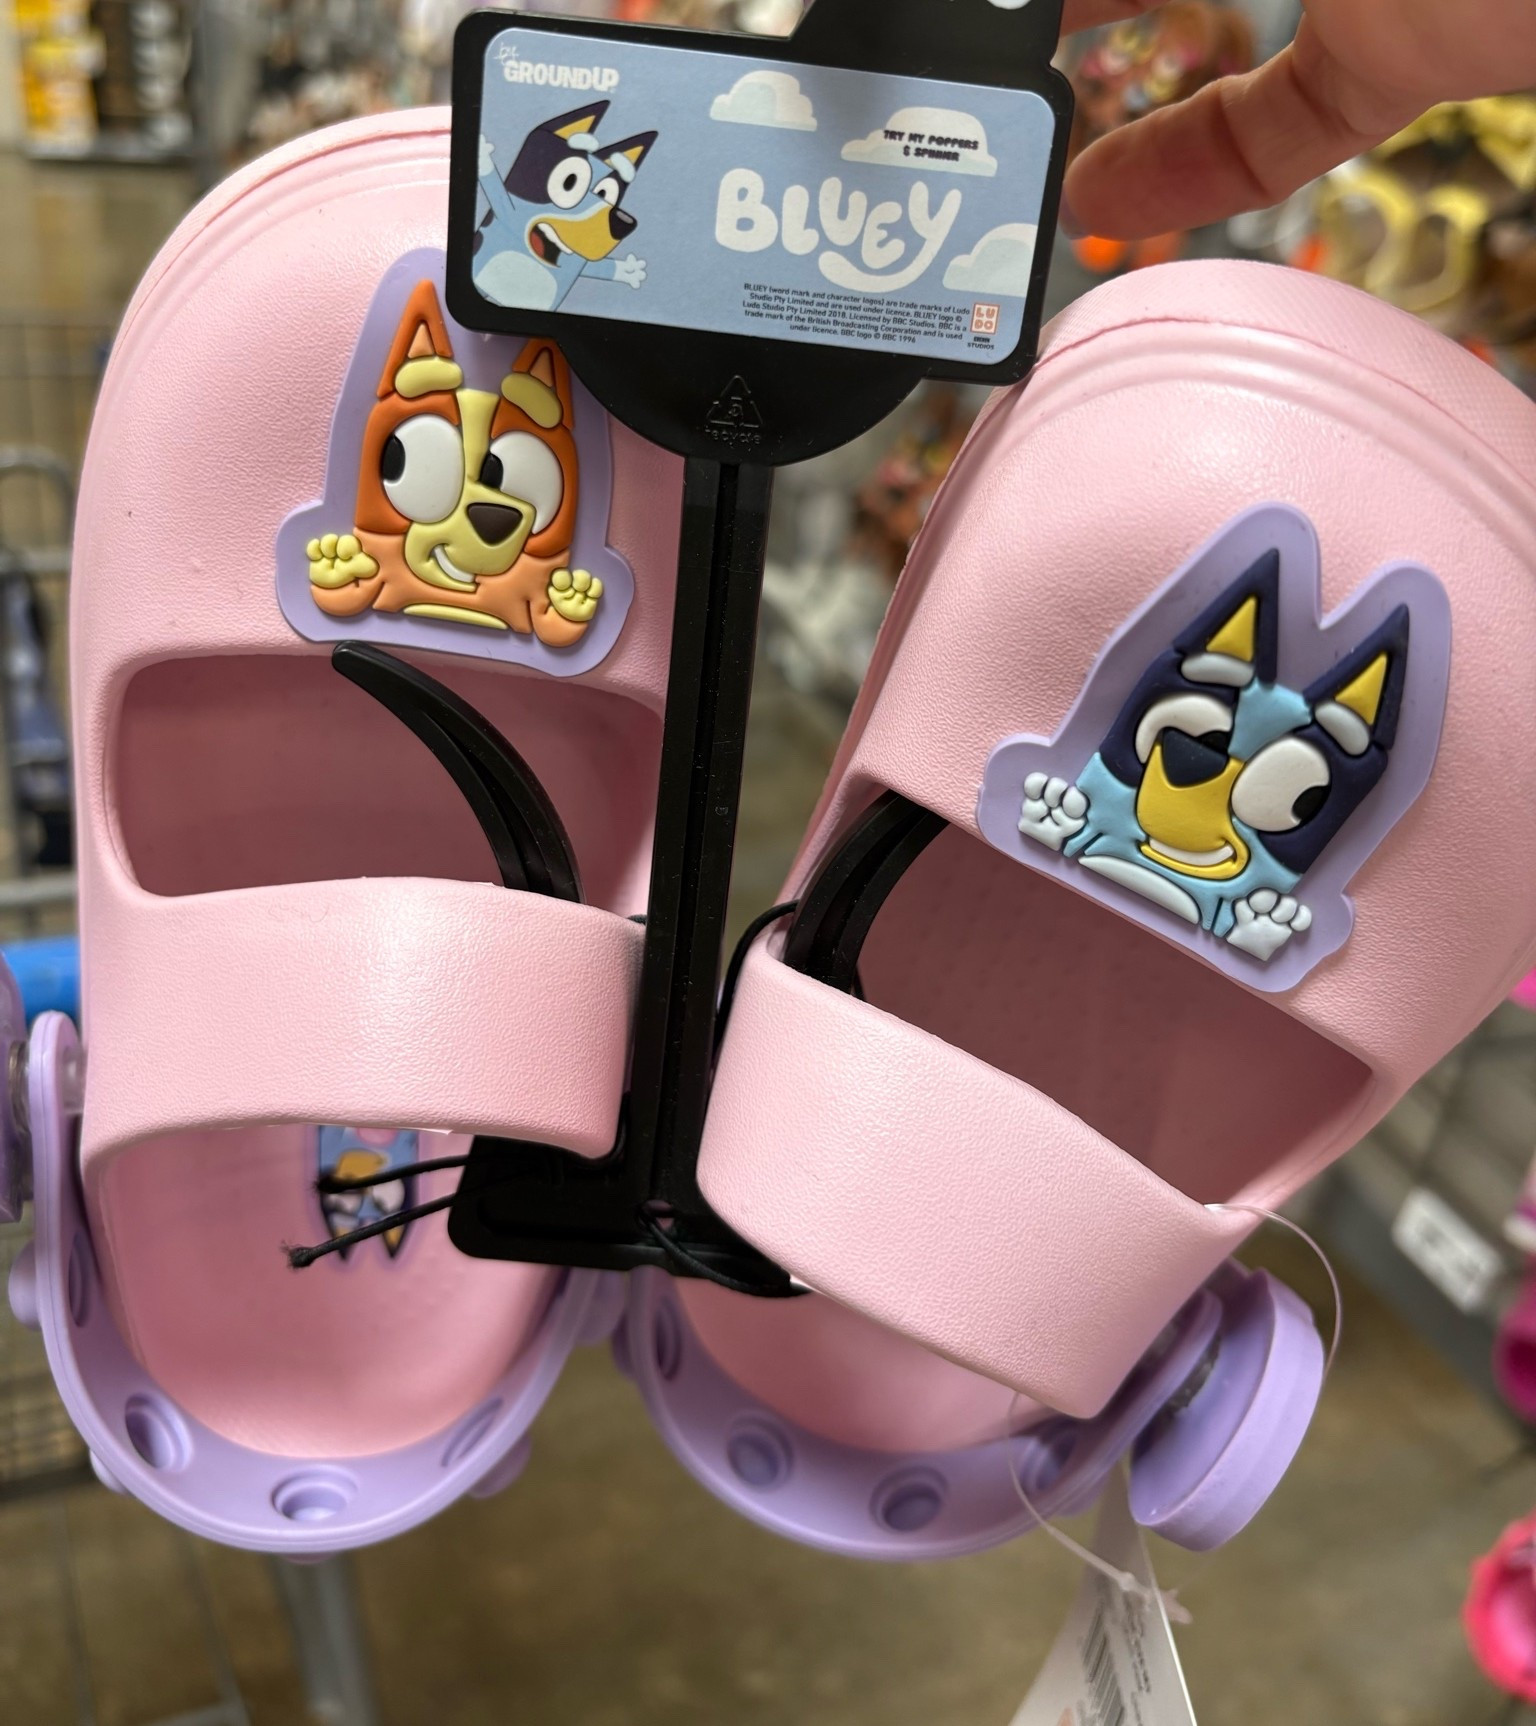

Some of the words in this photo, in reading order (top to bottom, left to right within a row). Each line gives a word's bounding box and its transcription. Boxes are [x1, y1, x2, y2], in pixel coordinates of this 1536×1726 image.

[503, 60, 620, 92] GROUNDUP
[883, 130, 905, 141] TRY
[908, 132, 925, 143] MY
[928, 135, 979, 150] POPPERS
[903, 145, 910, 156] &
[914, 147, 960, 162] SPINNER
[715, 168, 962, 293] BLUEY
[744, 283, 768, 292] BLUEY
[827, 293, 861, 303] character
[863, 297, 885, 306] logos)
[899, 301, 918, 309] trade
[920, 304, 942, 312] marks
[750, 293, 773, 301] Studio
[774, 296, 785, 304] Pty
[787, 297, 814, 306] Limited
[844, 304, 861, 312] used
[863, 306, 884, 315] under
[886, 308, 912, 318] licence.
[914, 311, 937, 320] BLUEY
[938, 314, 954, 323] logo
[743, 301, 760, 309] Ludo
[762, 303, 785, 312] Studio
[786, 306, 798, 314] Pty
[800, 307, 826, 317] Limited
[828, 310, 847, 319] 2018.
[849, 312, 881, 323] Licensed
[883, 316, 891, 324] by
[909, 320, 936, 329] Studios.
[938, 322, 953, 330] BBC
[744, 310, 764, 318] trade
[765, 312, 784, 320] mark
[808, 317, 831, 326] British
[833, 321, 879, 332] Broadcasting
[880, 325, 921, 336] Corporation
[923, 329, 936, 337] and
[946, 332, 963, 340] used
[812, 326, 839, 335] licence.
[841, 329, 855, 337] BBC
[899, 336, 916, 344] 1996
[967, 342, 994, 350] STUDIOS
